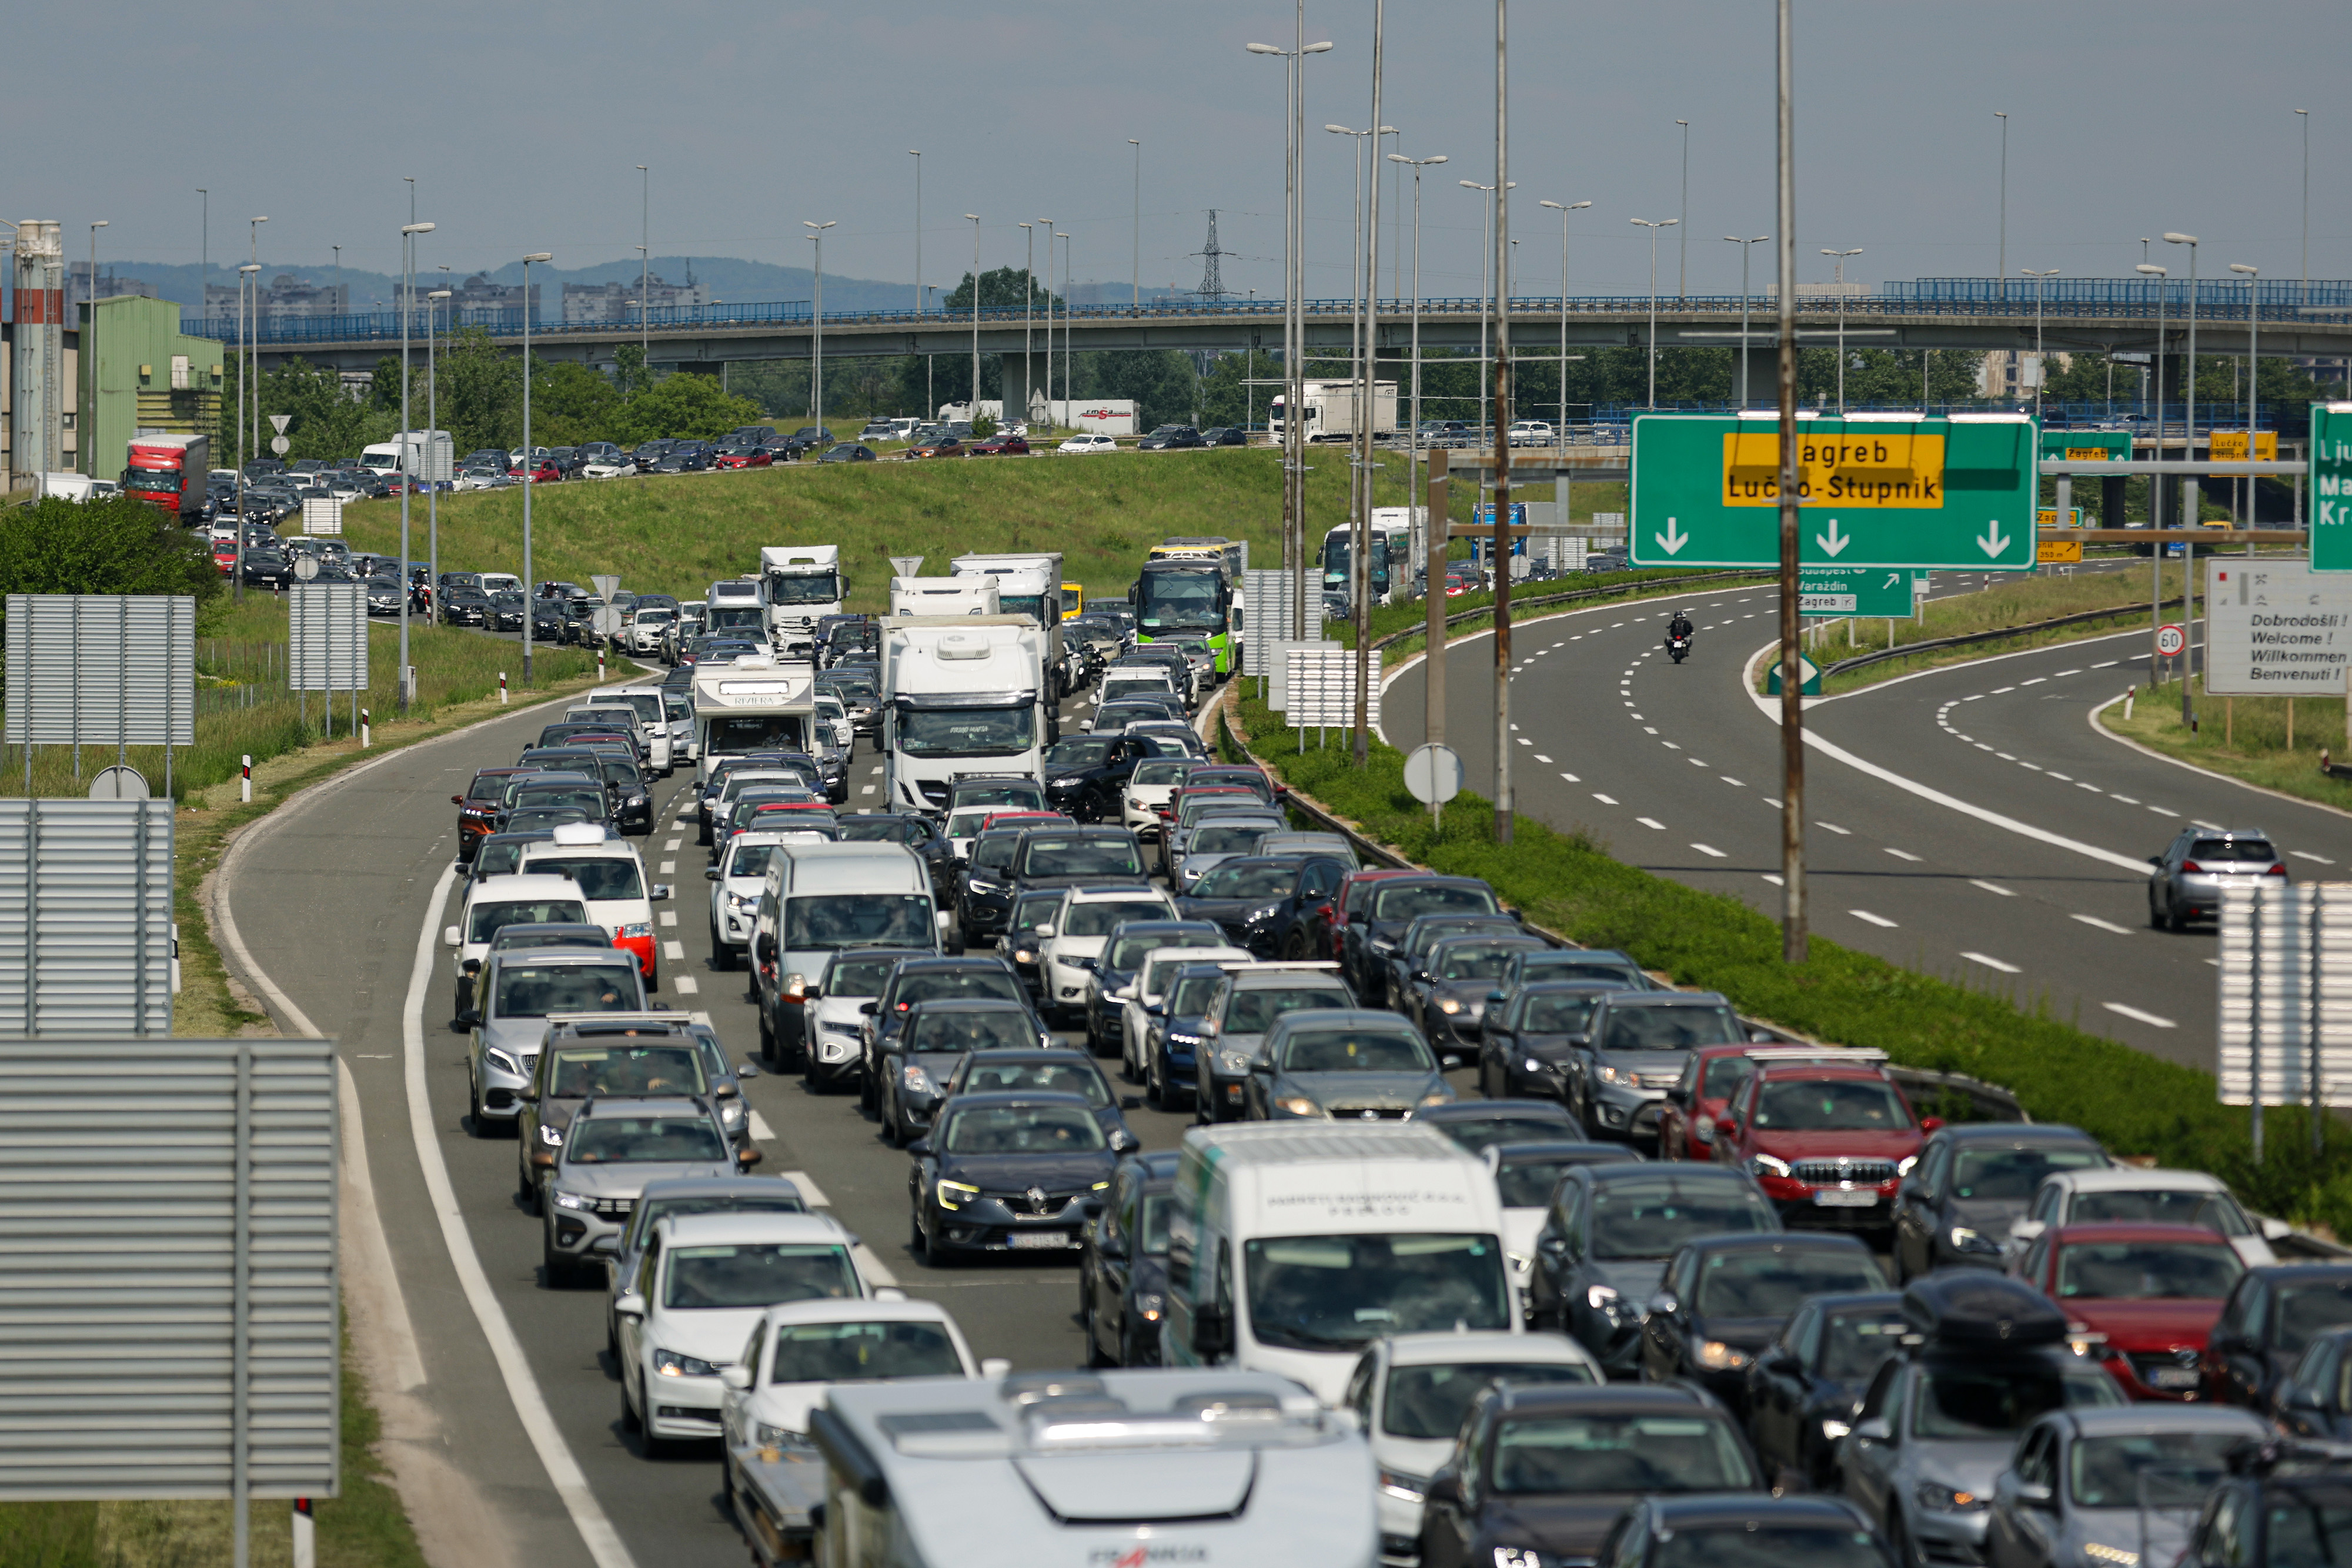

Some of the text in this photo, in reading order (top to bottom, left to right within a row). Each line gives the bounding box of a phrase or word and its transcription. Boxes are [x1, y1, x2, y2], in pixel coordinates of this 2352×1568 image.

[1802, 440, 1887, 468] agreb
[2068, 449, 2107, 460] Zagreb
[2216, 451, 2249, 460] Stupnik
[1729, 474, 1937, 504] Lučo-Stupnik
[2037, 513, 2075, 523] Zagb
[2319, 500, 2352, 525] Kr
[1798, 596, 1836, 609] Zagreb
[2251, 614, 2338, 627] Dobrodošli
[2161, 633, 2179, 647] 60
[2251, 631, 2323, 644] Welcome
[2251, 650, 2347, 663] Willkommen
[2250, 667, 2331, 680] Benvenuti
